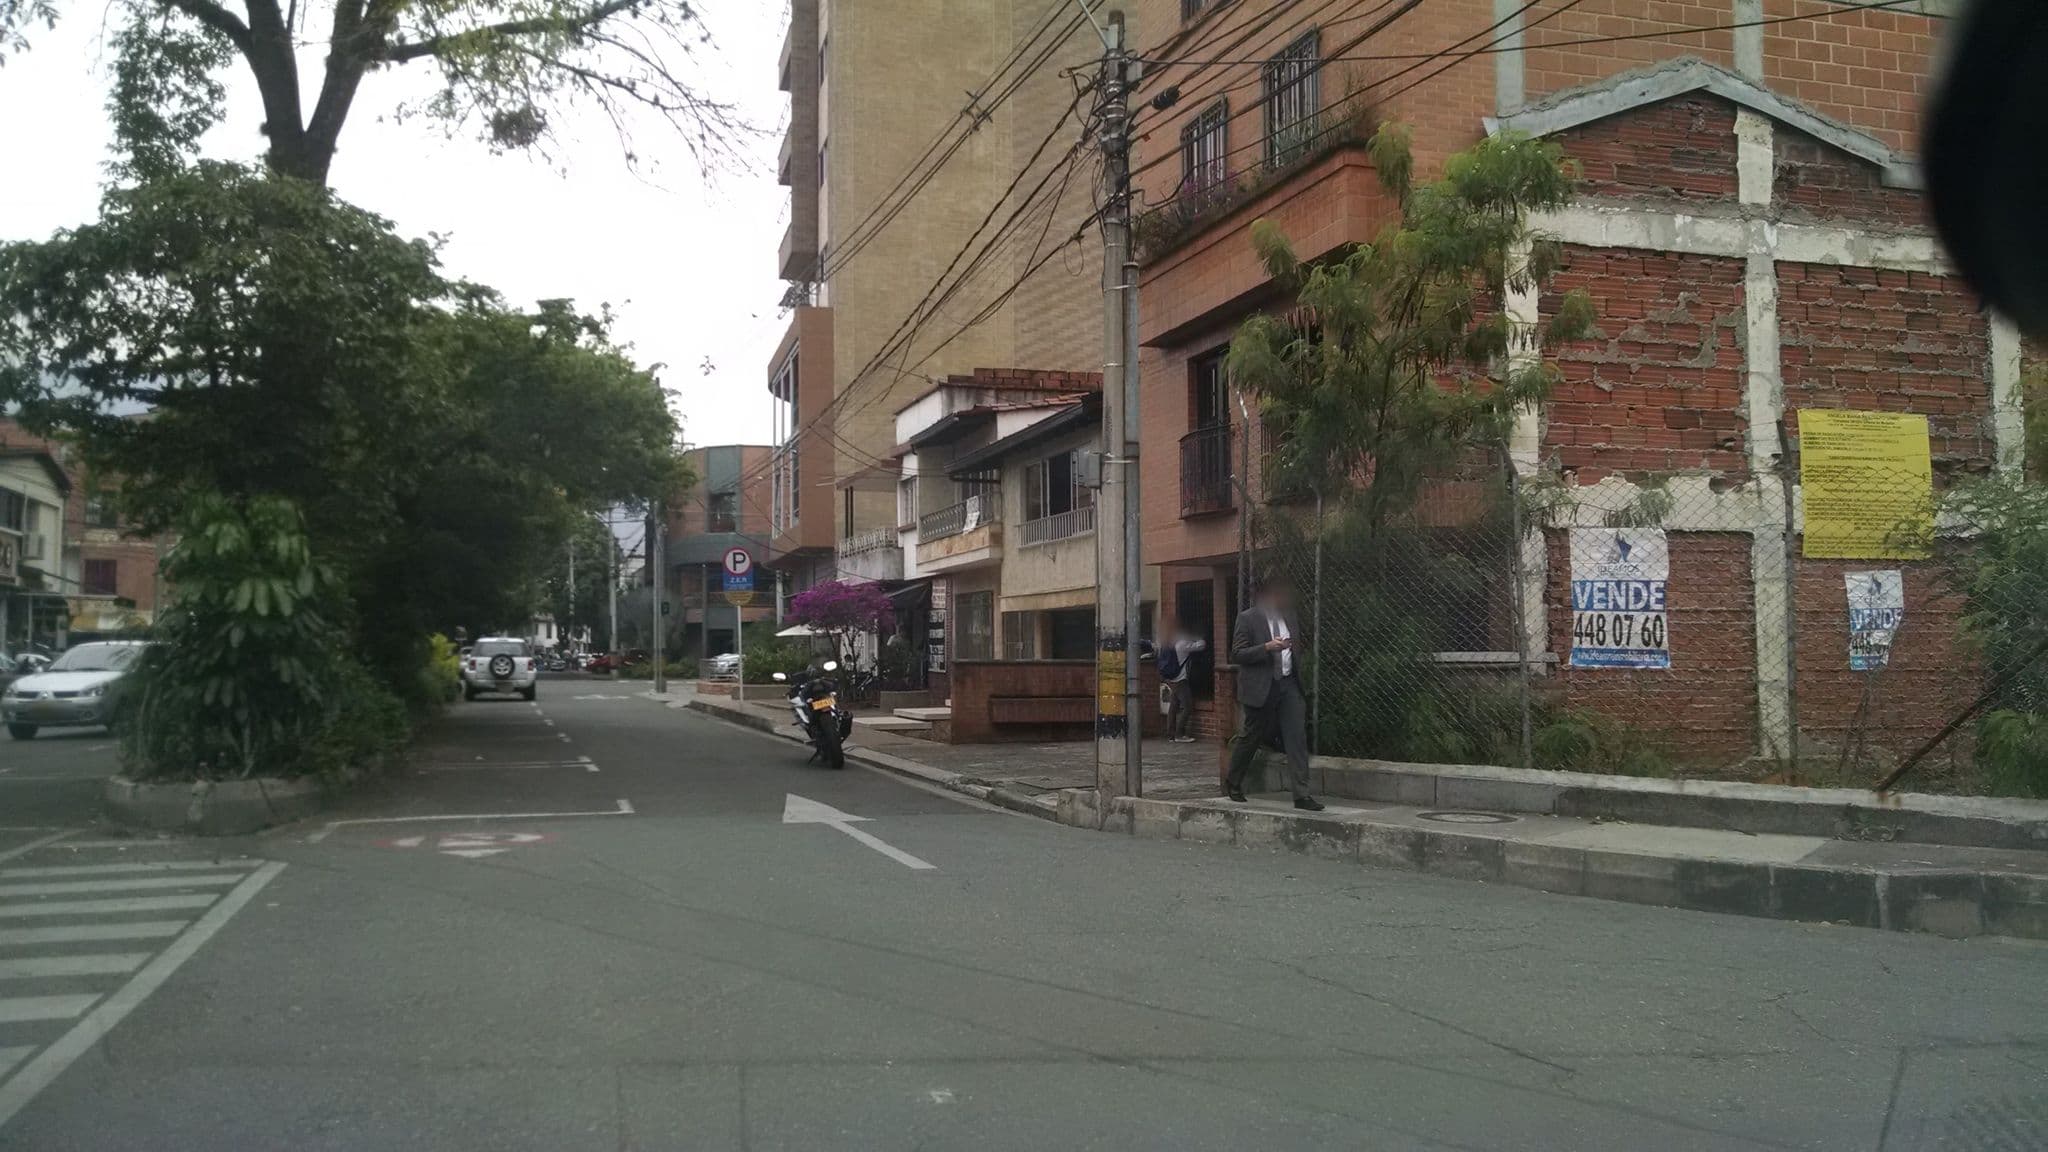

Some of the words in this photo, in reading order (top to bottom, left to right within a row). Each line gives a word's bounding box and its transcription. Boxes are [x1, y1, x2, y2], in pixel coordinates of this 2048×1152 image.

[732, 552, 746, 571] P
[1573, 581, 1665, 611] VENDE
[1574, 613, 1607, 647] 448
[1612, 613, 1634, 647] 07
[1641, 614, 1664, 648] 60
